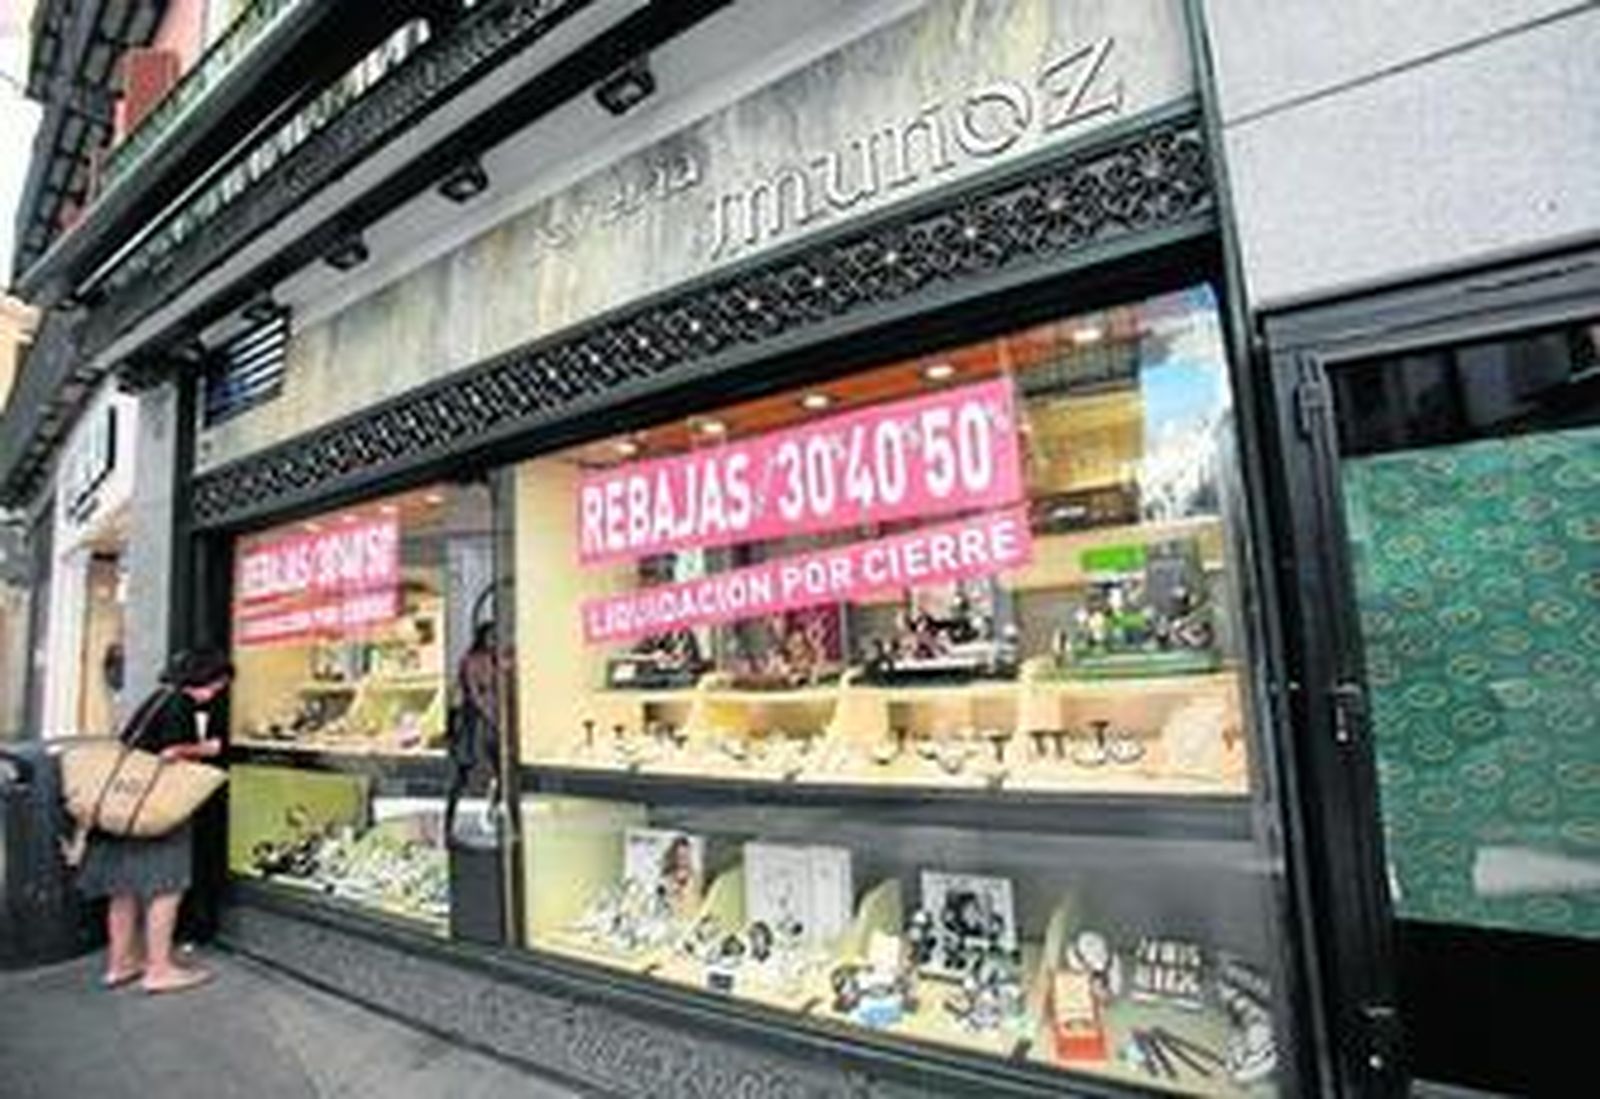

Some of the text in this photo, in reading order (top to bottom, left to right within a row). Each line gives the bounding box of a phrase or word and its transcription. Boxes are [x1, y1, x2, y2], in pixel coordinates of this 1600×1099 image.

[581, 453, 751, 553] REBAJAS
[781, 558, 852, 601] POR
[861, 519, 1018, 584] CIERRE
